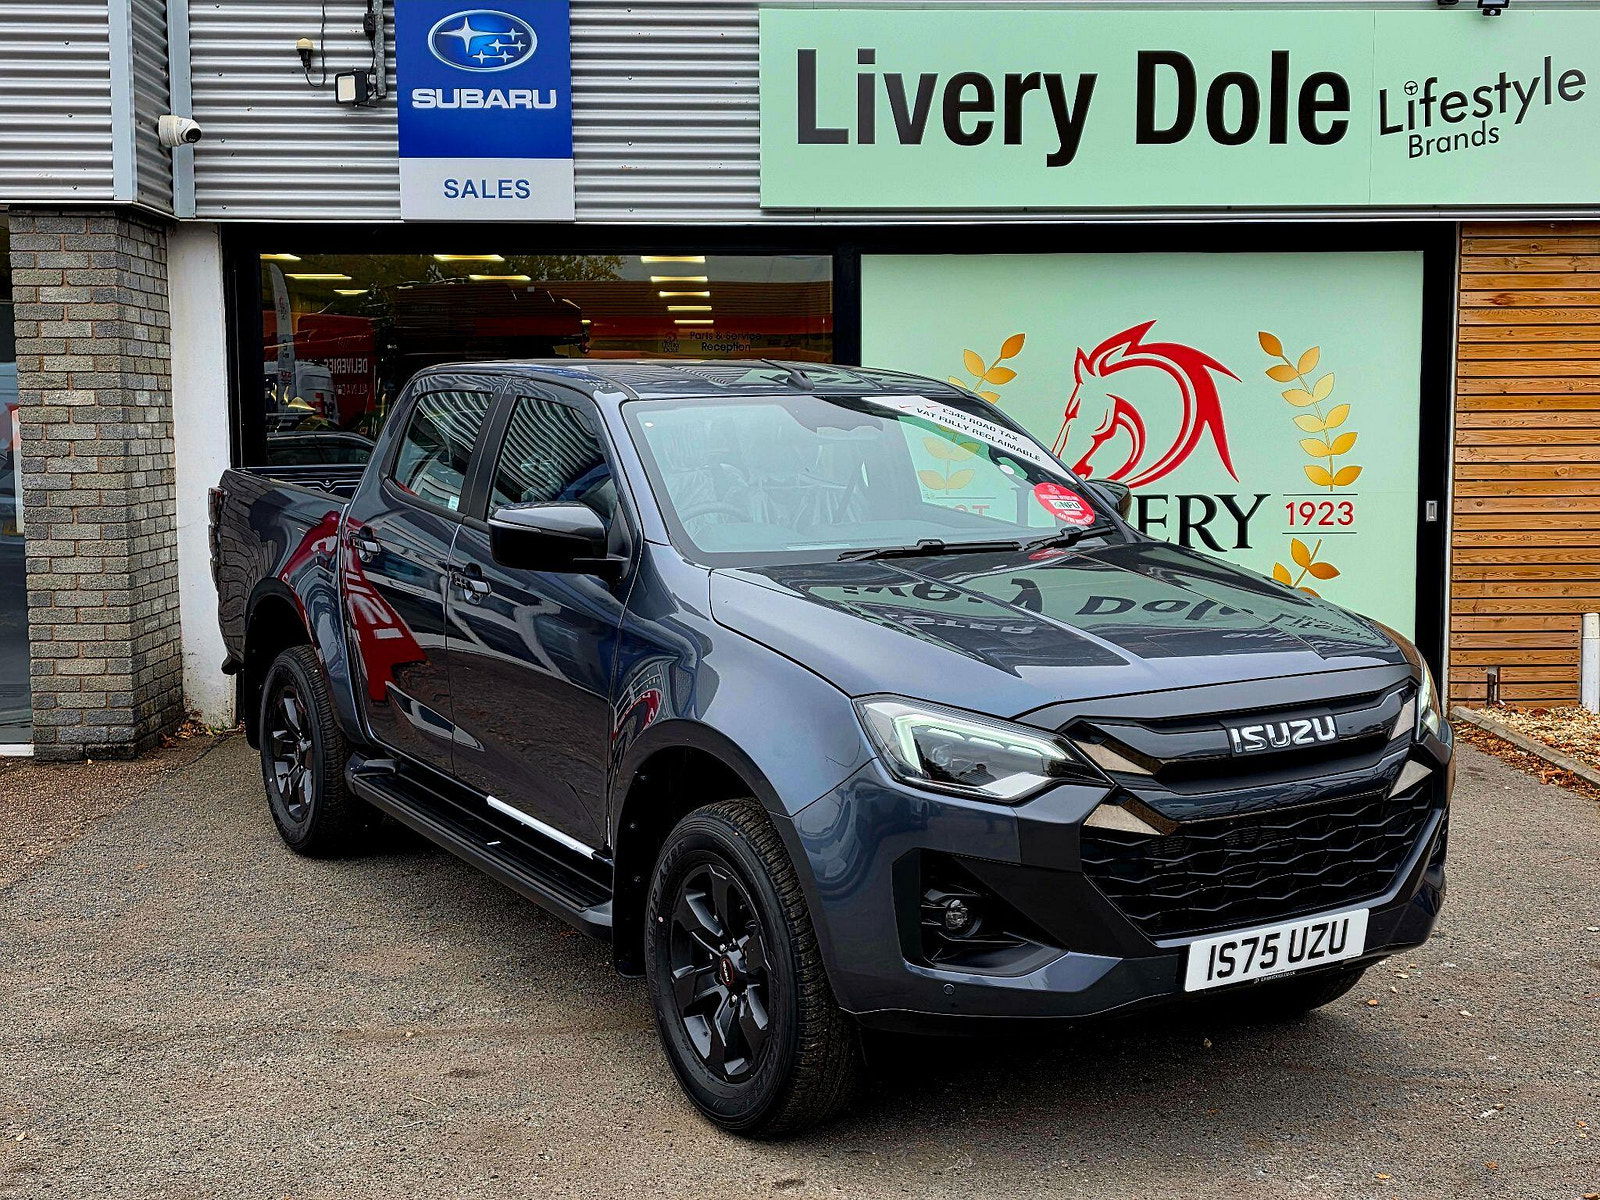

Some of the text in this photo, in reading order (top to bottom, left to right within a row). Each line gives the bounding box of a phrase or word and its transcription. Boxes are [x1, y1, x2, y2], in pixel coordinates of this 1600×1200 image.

[411, 88, 557, 109] SUBARU
[797, 48, 1351, 167] Livery Dole
[1379, 55, 1587, 136] Lifestyle
[1408, 120, 1500, 158] Brands
[443, 179, 531, 199] SALES
[690, 331, 761, 341] Parts & Service
[701, 342, 751, 353] Reception
[916, 408, 1041, 462] VAT FULLY RECLAIMABLE
[968, 417, 996, 434] ROAD
[999, 430, 1018, 442] TAX
[1286, 501, 1355, 526] 1923
[1230, 715, 1338, 754] ISUZU
[1206, 918, 1350, 981] IS75 UZU
